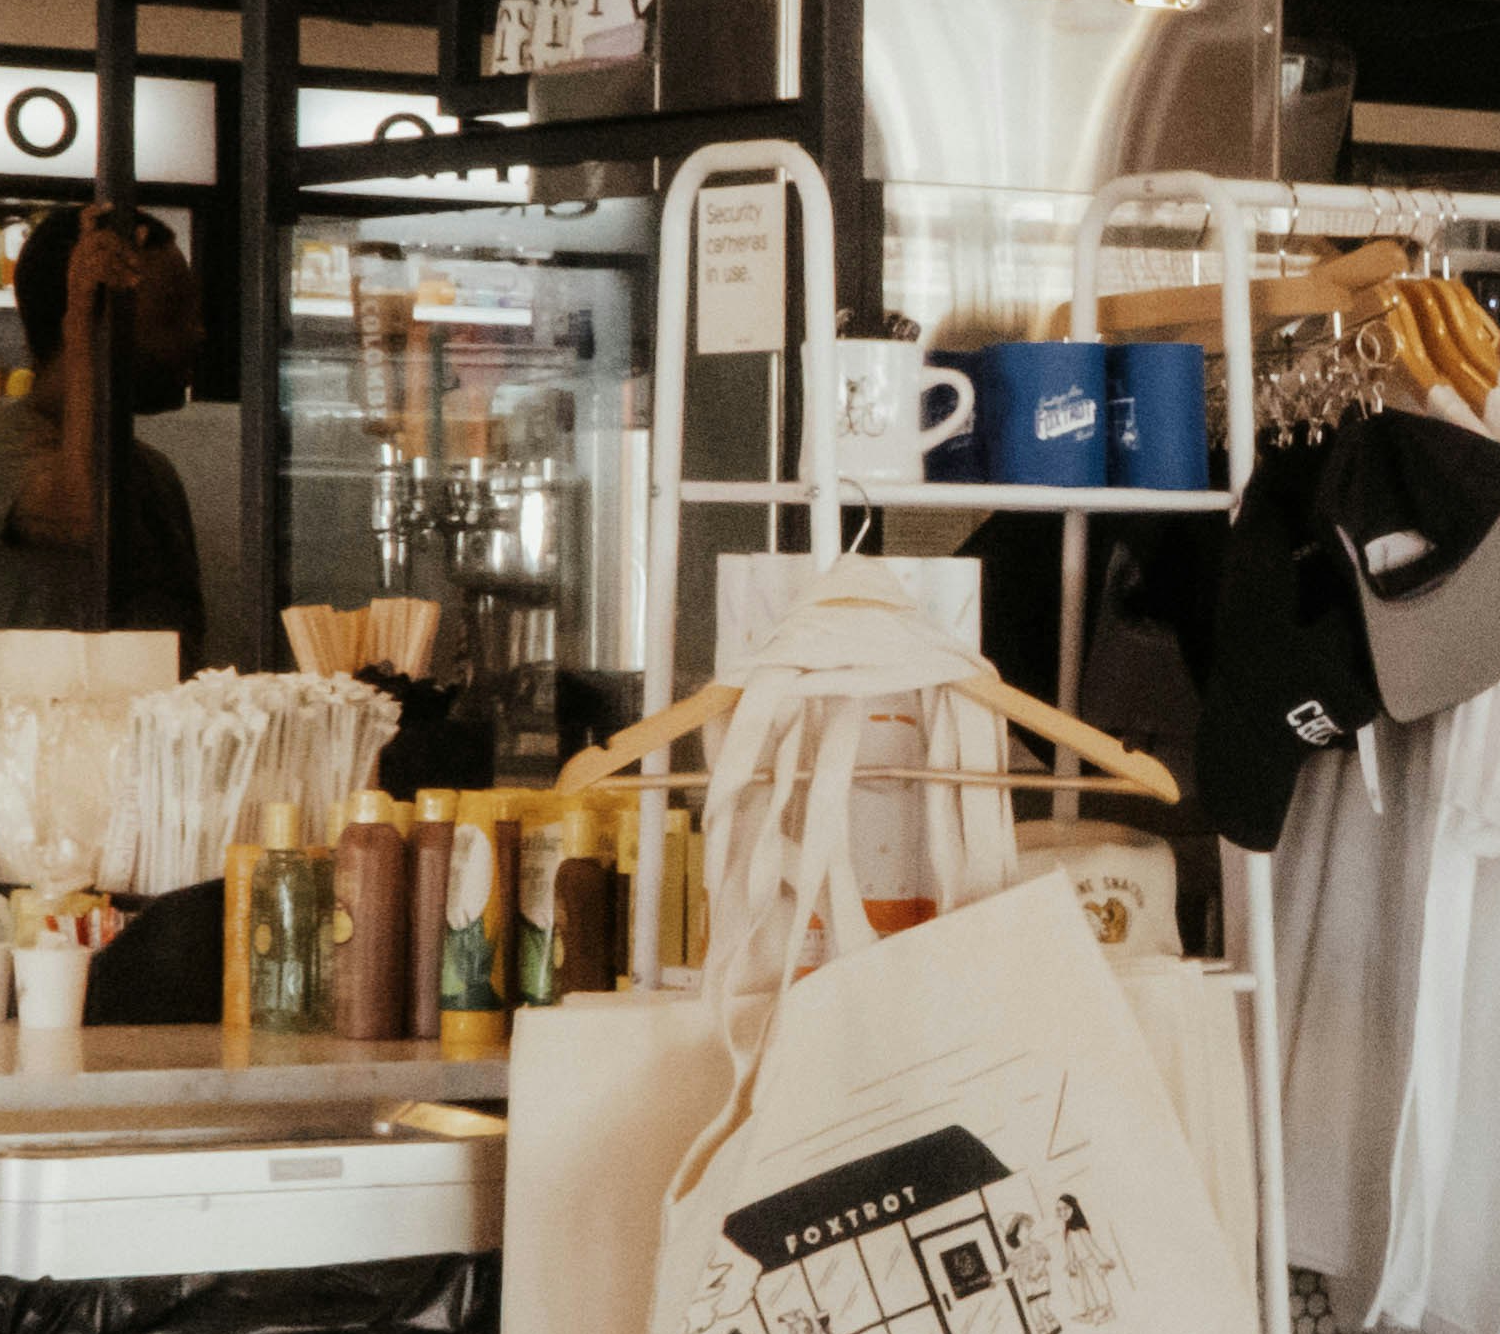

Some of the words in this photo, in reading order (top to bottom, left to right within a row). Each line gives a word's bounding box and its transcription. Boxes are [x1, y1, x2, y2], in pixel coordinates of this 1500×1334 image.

[705, 203, 762, 228] Security
[706, 232, 768, 255] cameras
[706, 267, 719, 283] in
[724, 265, 753, 283] use.
[786, 1183, 919, 1254] FOXTROT
